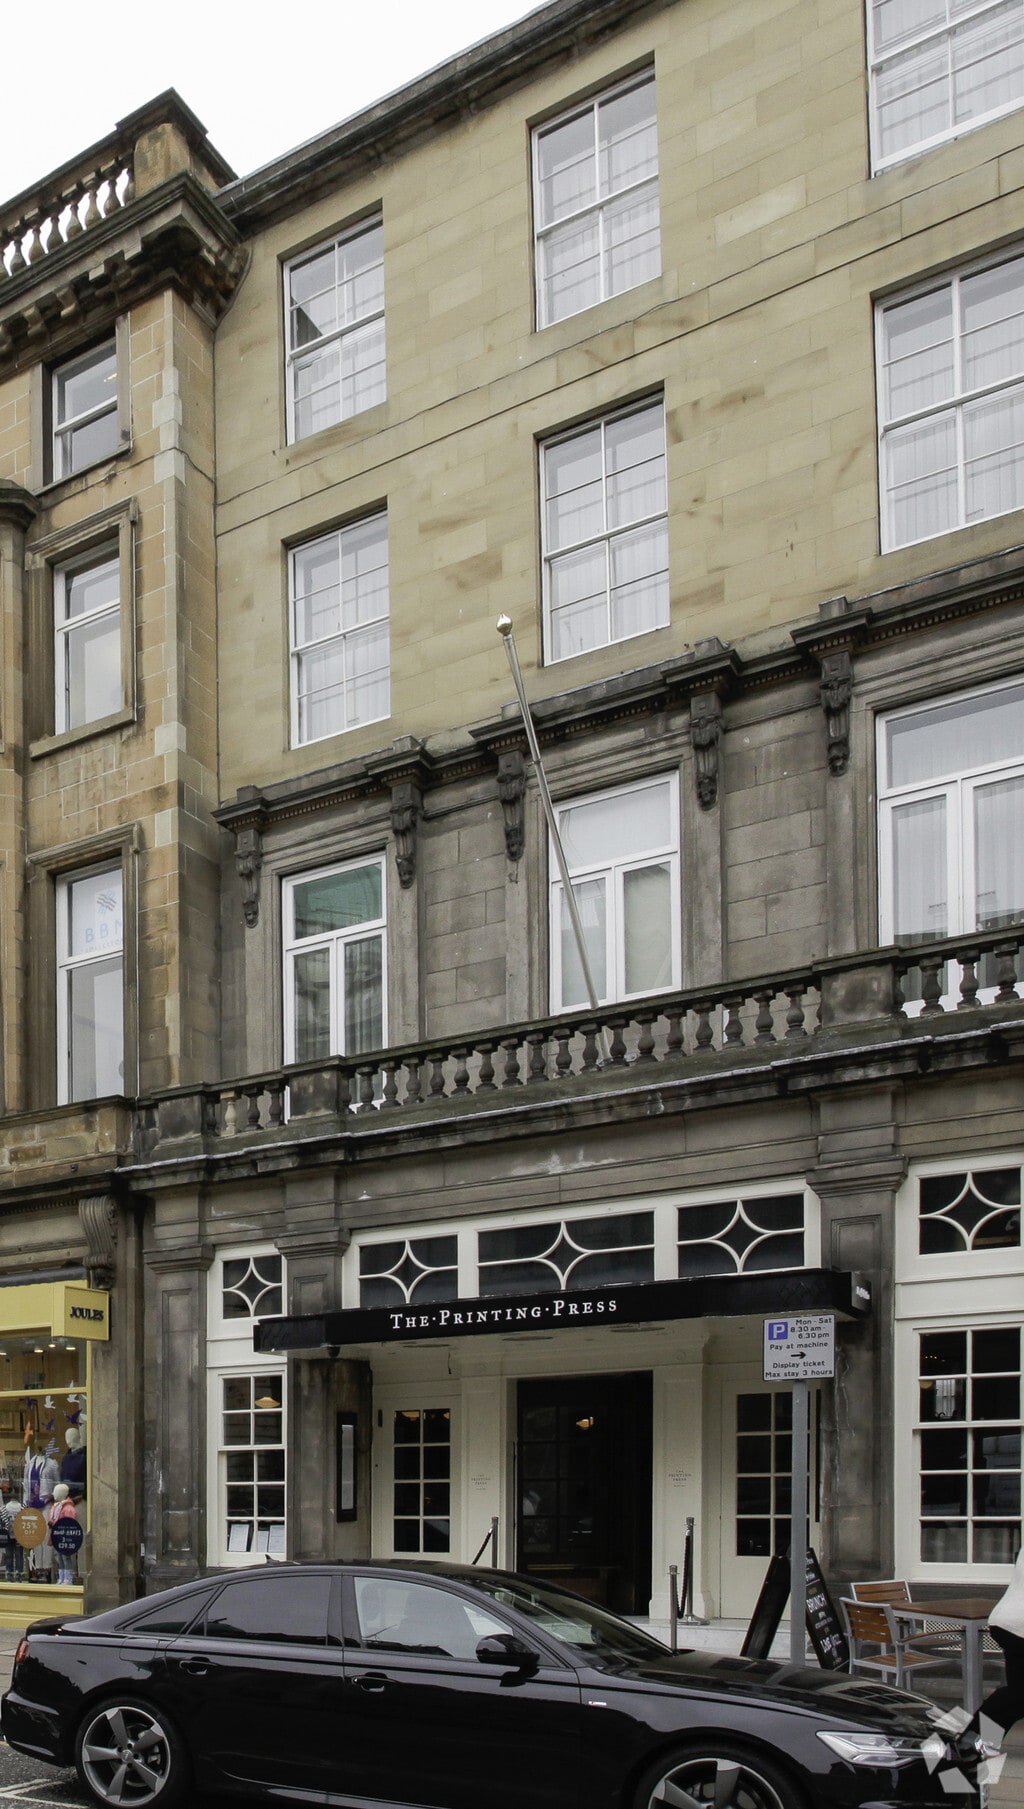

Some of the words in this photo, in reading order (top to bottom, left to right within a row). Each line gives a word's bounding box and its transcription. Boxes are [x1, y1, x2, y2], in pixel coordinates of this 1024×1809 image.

[70, 1306, 104, 1321] JOULES
[773, 1324, 786, 1339] P
[797, 1341, 828, 1349] machine
